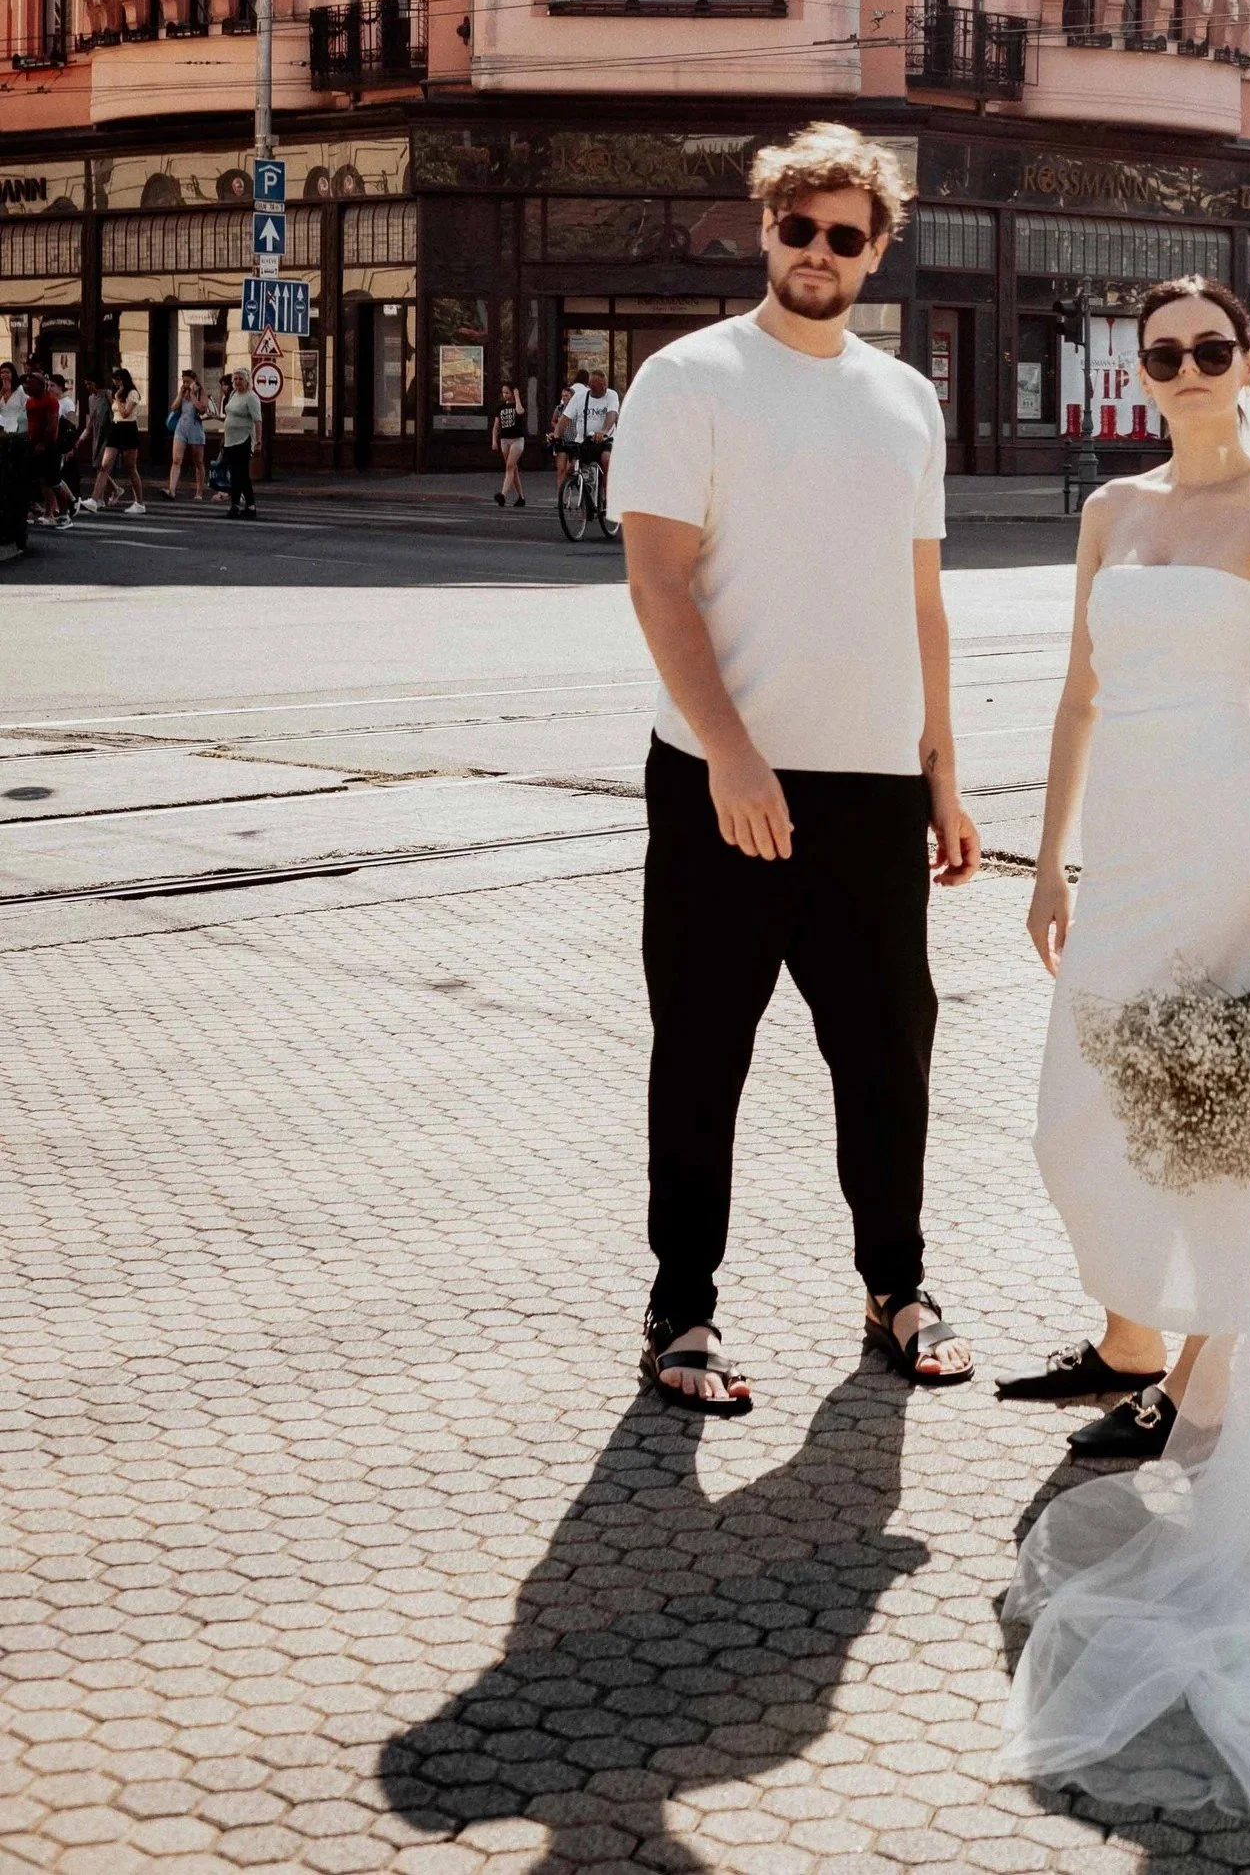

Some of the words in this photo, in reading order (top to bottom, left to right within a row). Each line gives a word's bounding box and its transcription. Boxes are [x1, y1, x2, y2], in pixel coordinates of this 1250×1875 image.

[559, 143, 746, 176] ROSSMAN
[0, 177, 47, 203] ANN
[264, 171, 278, 195] P
[1023, 164, 1150, 203] ROSSMANN
[1082, 369, 1130, 399] VIP
